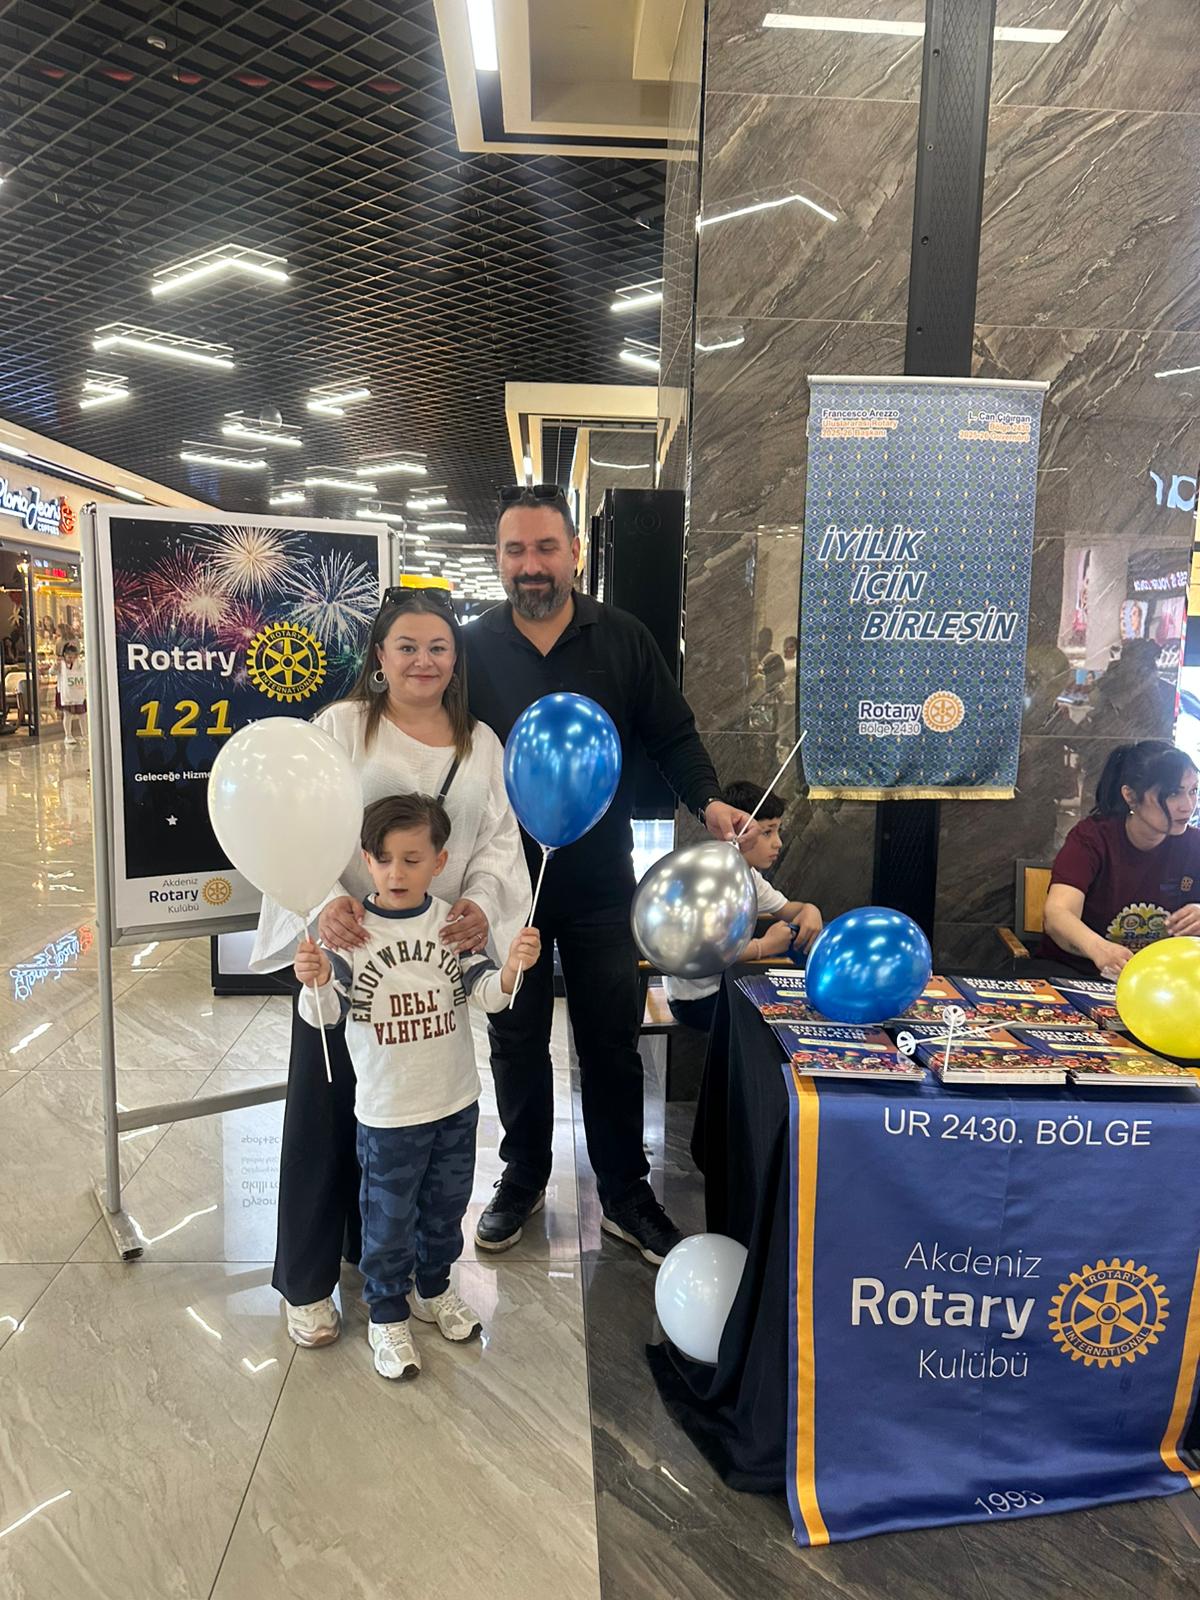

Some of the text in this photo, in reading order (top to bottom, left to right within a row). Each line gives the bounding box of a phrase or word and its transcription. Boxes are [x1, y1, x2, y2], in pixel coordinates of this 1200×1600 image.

[822, 408, 899, 418] Francesco Arezzo
[818, 525, 926, 561] İYİLİK
[851, 565, 927, 604] İÇİN
[269, 630, 303, 641] ROTARY
[861, 605, 1018, 644] BİRLEŞİN
[127, 643, 236, 676] Rotary
[261, 673, 316, 694] INTERNATIONAL
[136, 700, 233, 737] 121
[860, 701, 921, 721] Rotary
[860, 722, 920, 735] Bölge 2430
[135, 772, 181, 782] Geleceğe
[149, 889, 199, 903] Rotary
[162, 878, 198, 888] Akdeniz
[168, 903, 200, 914] Kulübü
[352, 960, 384, 1023] ENJOY
[376, 939, 436, 969] WHAT
[438, 949, 464, 984] YOU
[884, 1107, 1152, 1146] UR 2430. BÖLGE
[904, 1242, 1042, 1278] Akdeniz
[1089, 1271, 1139, 1284] ROTARY
[851, 1277, 1036, 1340] Rotary
[1065, 1330, 1149, 1357] INTERNATIONAL
[919, 1349, 1029, 1379] Kulübü
